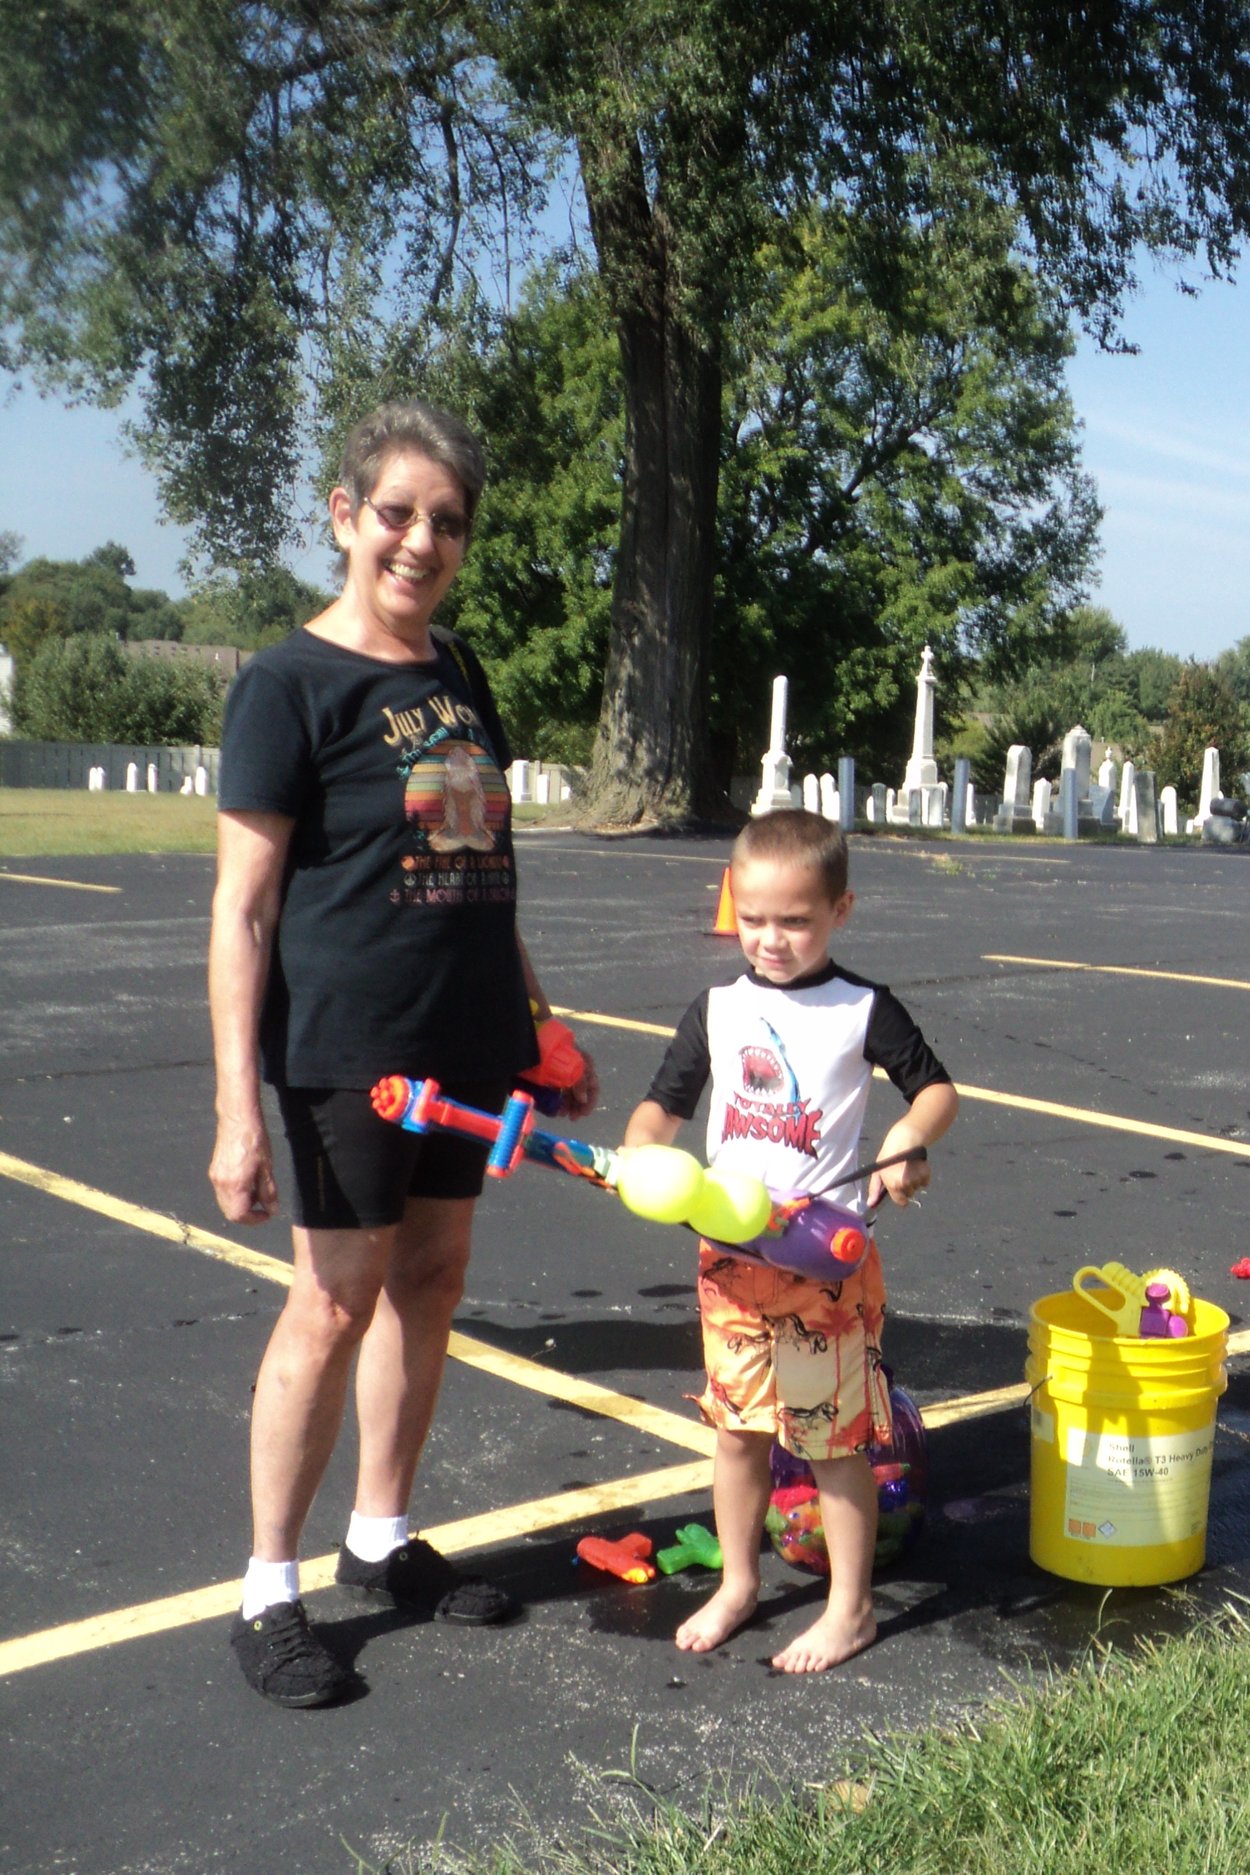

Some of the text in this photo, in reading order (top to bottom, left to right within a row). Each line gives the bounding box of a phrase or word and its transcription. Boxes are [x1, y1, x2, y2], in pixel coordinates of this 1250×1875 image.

[382, 707, 426, 746] JULY
[734, 1091, 811, 1114] TOTALLY
[1155, 1455, 1167, 1464] T3
[1169, 1452, 1194, 1464] Heavy
[1133, 1467, 1169, 1478] 15W-40
